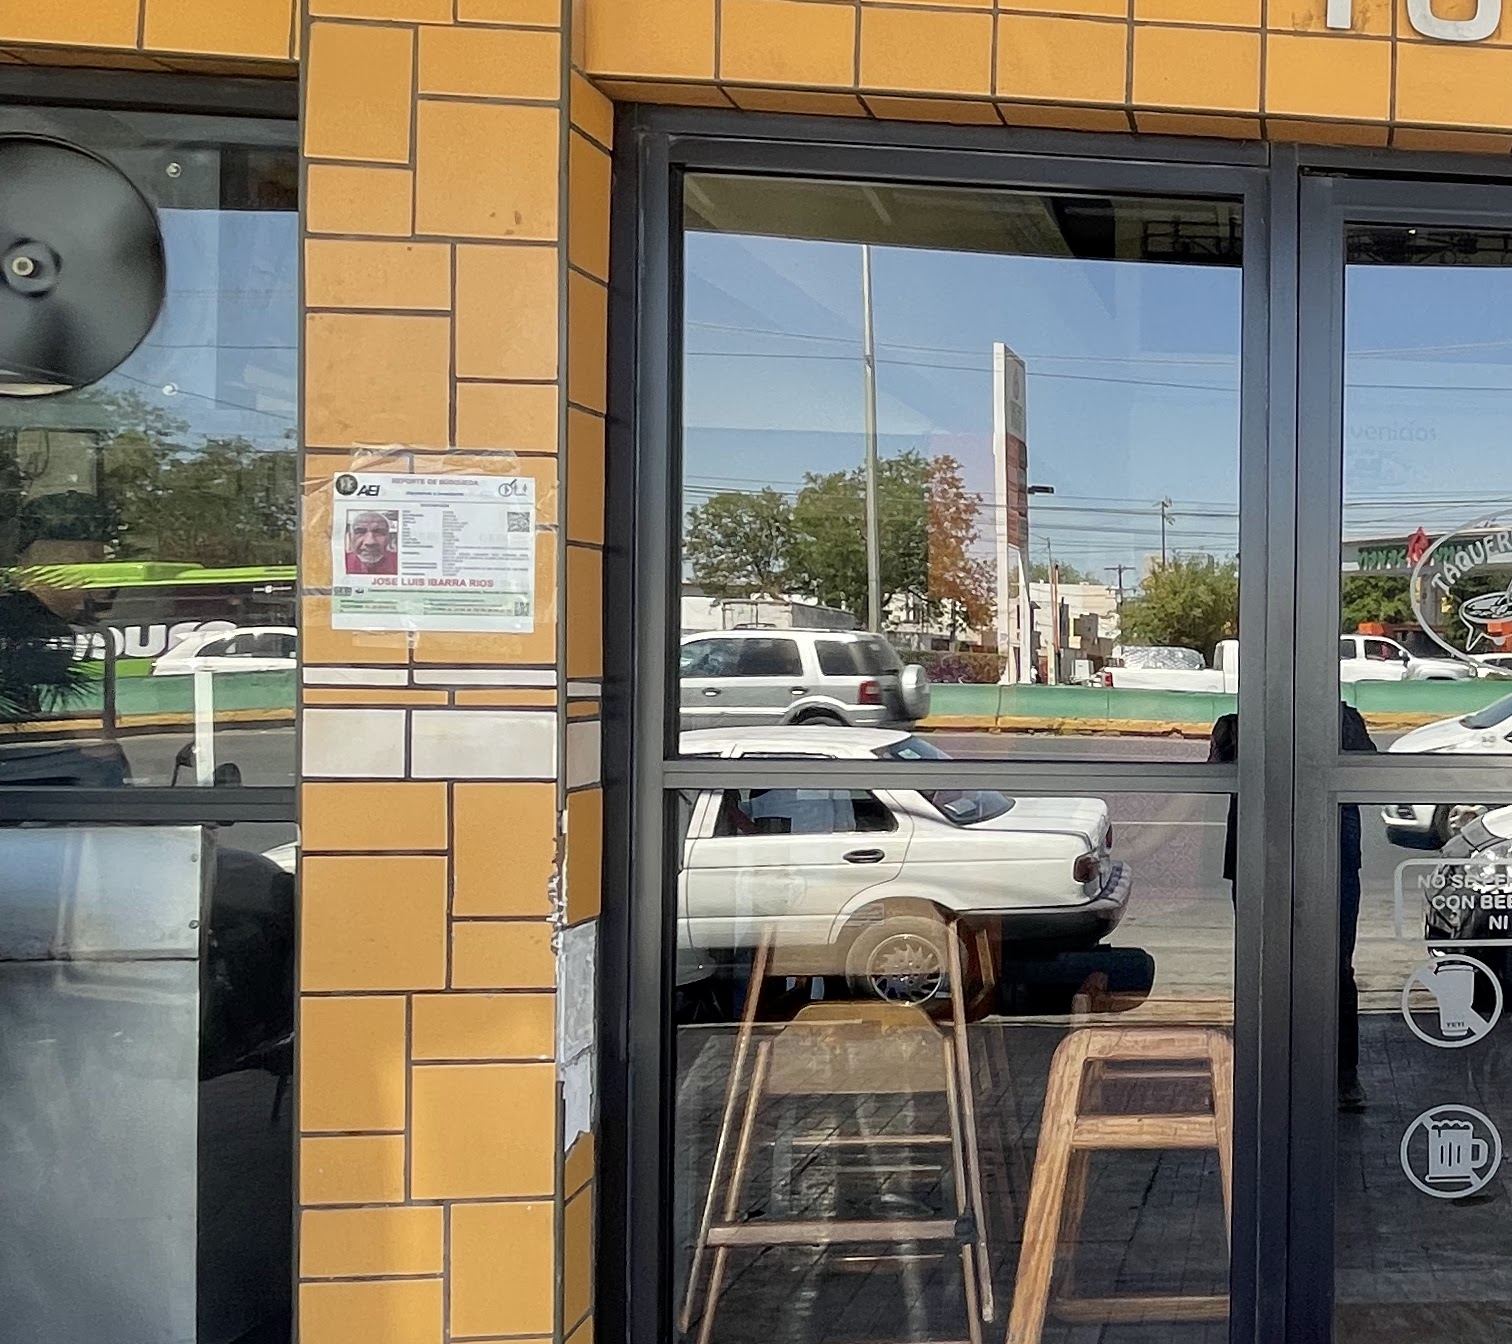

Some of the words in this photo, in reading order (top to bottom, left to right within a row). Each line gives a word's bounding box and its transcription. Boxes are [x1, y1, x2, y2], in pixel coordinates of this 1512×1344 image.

[371, 577, 399, 586] JOSE
[401, 578, 425, 586] LUIS
[428, 578, 466, 587] IBARRA
[469, 579, 494, 587] RIOS
[1417, 873, 1446, 889] NO
[1432, 895, 1475, 909] CON
[1489, 915, 1509, 930] NI
